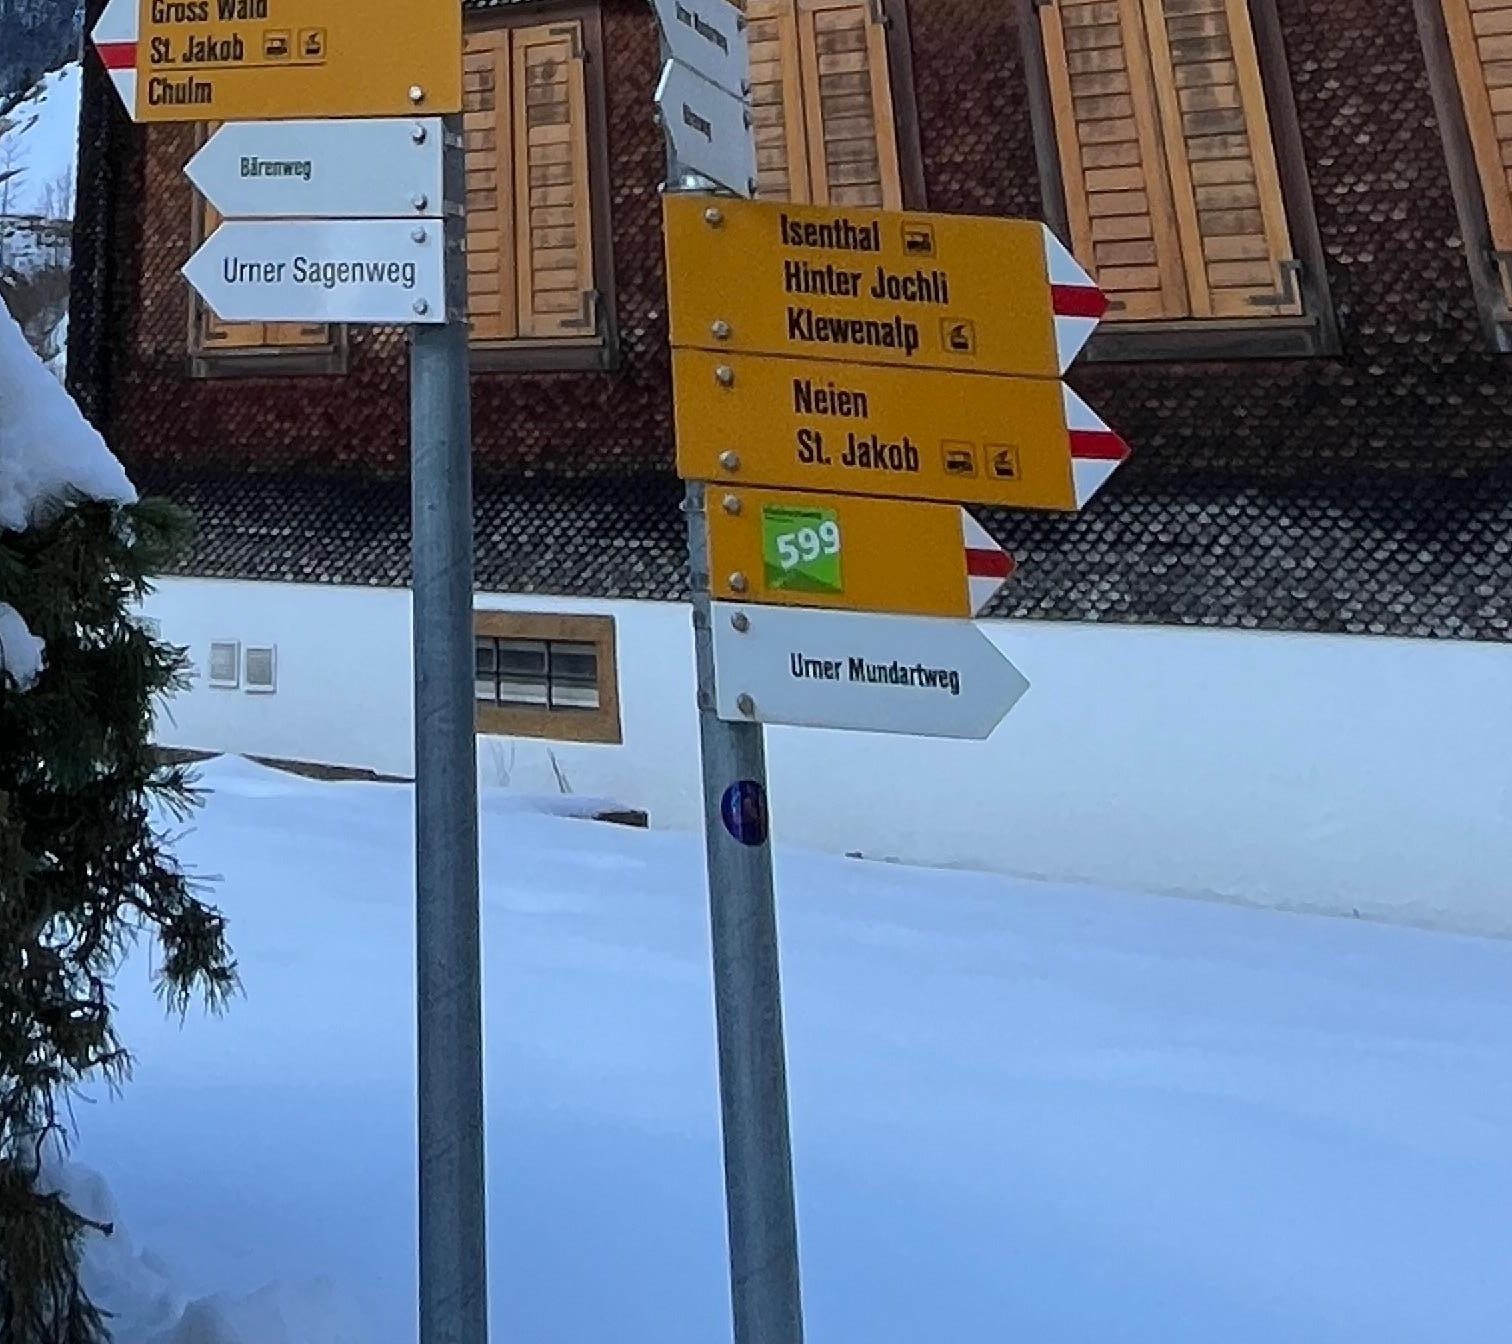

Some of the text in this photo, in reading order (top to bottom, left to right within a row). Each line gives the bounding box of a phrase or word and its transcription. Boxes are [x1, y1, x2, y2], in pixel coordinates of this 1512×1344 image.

[182, 32, 244, 62] Jakob
[148, 75, 212, 105] Chulm
[240, 156, 312, 181] Bärenweg
[780, 213, 880, 252] Isenthal
[224, 256, 416, 289] Urner Sagenweg
[784, 259, 949, 305] Hinter Jochli
[787, 307, 919, 357] Klewenalp
[792, 378, 868, 418] Neien
[797, 428, 920, 472] St. Jakob
[776, 520, 840, 572] 599
[790, 652, 960, 695] Urner Mundartweg
